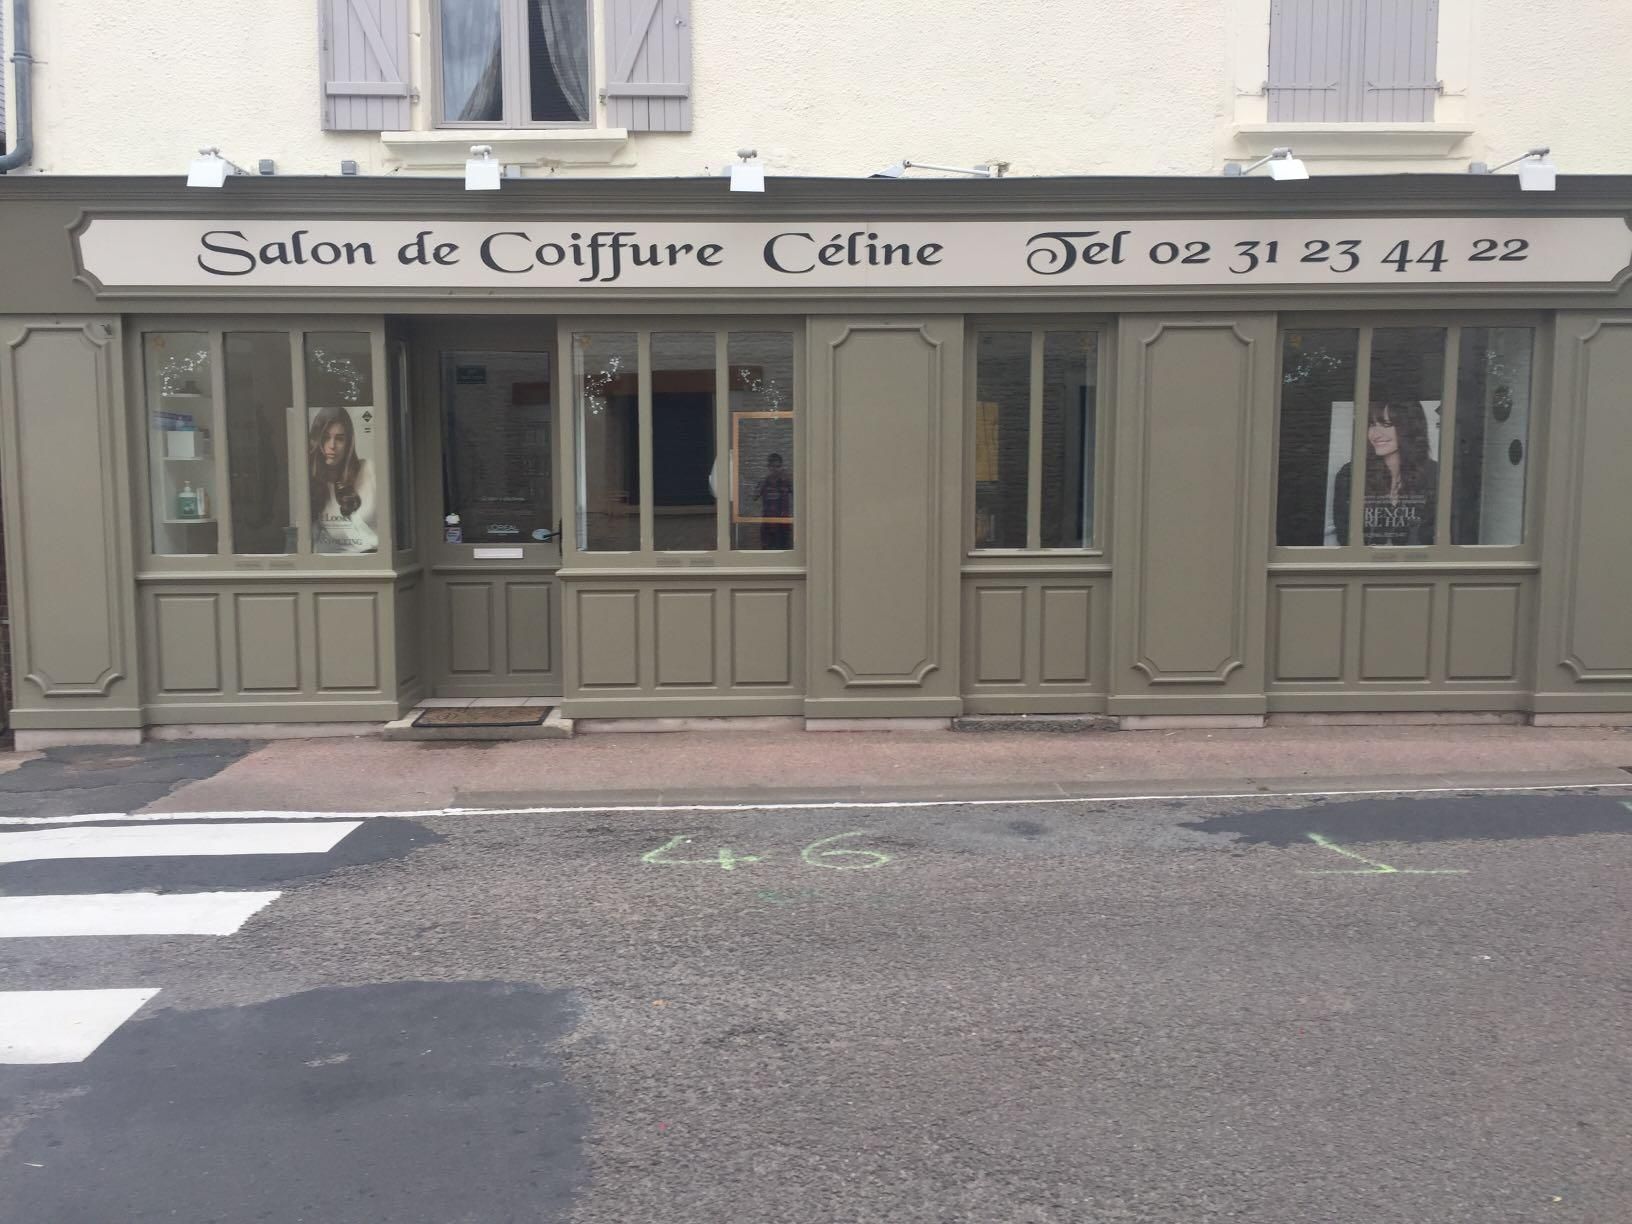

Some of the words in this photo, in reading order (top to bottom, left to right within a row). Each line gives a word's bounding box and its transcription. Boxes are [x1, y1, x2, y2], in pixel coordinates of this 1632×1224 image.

[197, 230, 375, 276] Salon
[397, 231, 459, 266] de
[480, 231, 725, 283] Coiffure
[763, 232, 945, 275] Céline
[1026, 230, 1131, 275] Tel
[1149, 240, 1211, 265] 02
[1228, 240, 1279, 274] 31
[1300, 239, 1362, 273] 23
[1380, 239, 1449, 273] 44
[1467, 238, 1530, 263] 22
